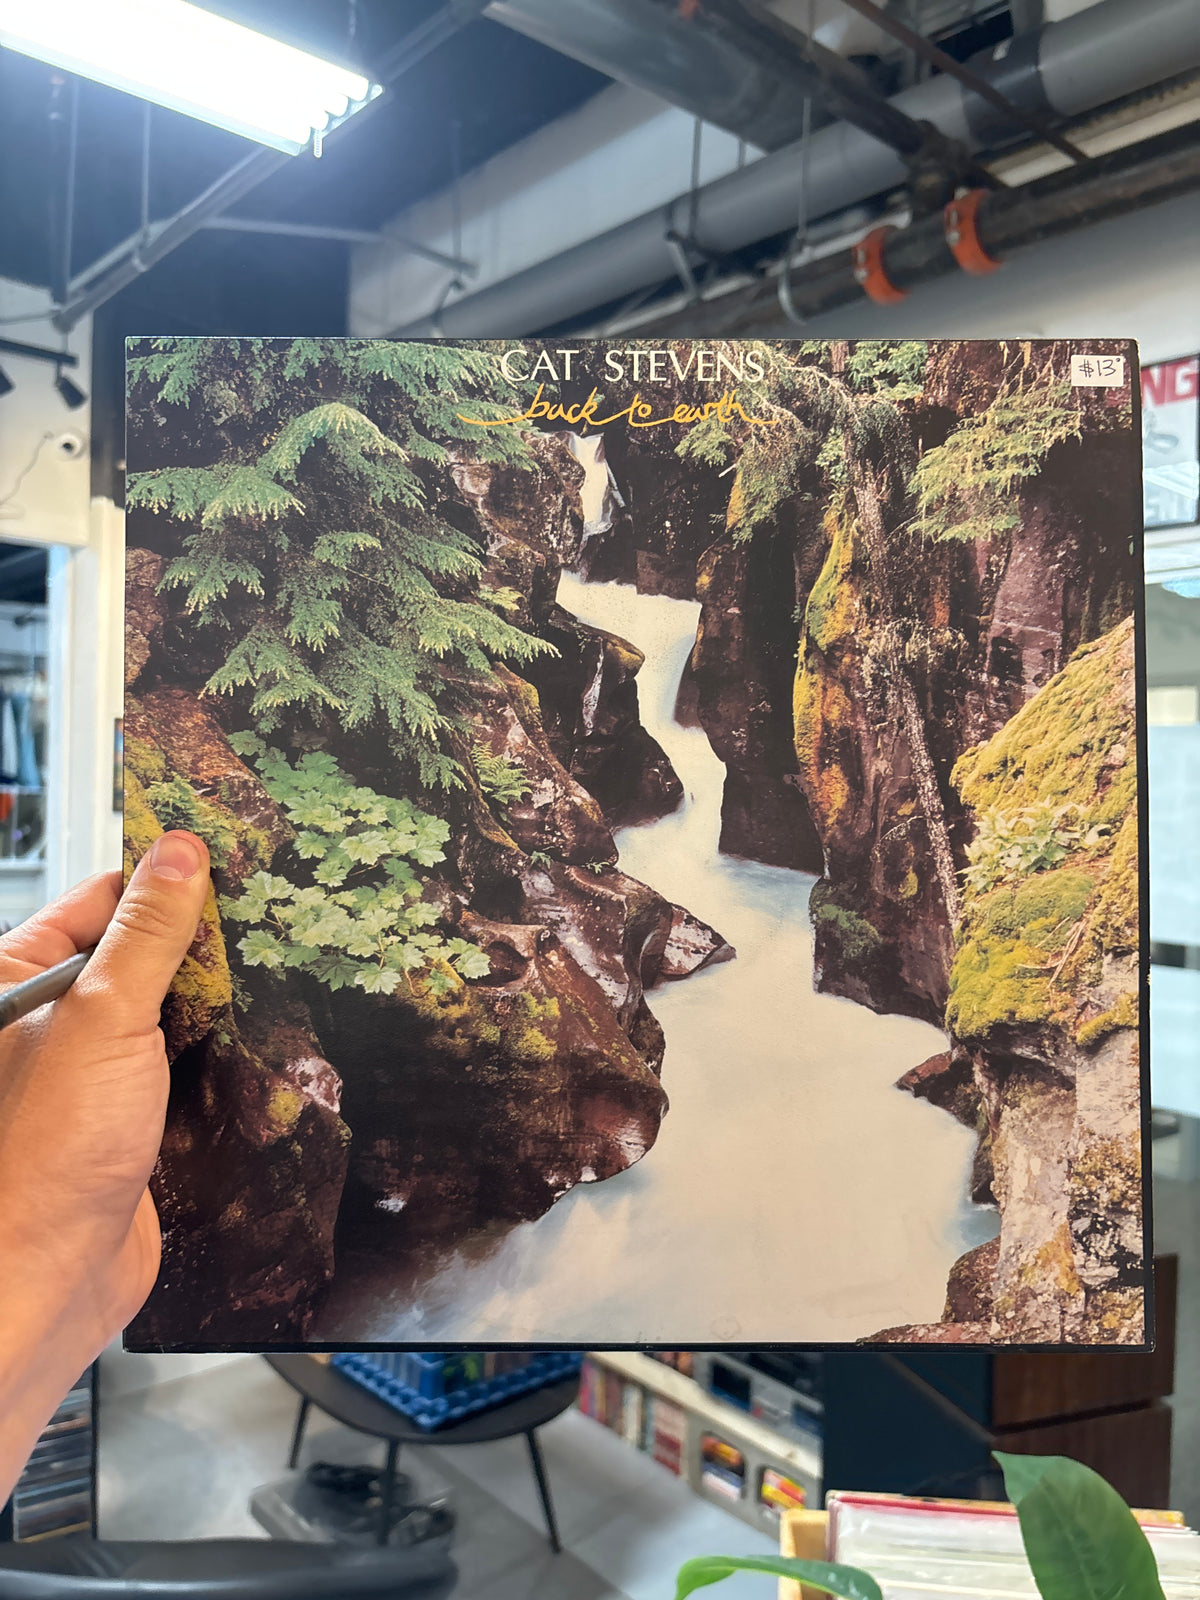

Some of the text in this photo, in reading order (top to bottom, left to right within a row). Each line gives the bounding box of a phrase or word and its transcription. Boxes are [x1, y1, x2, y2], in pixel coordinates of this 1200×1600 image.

[501, 349, 765, 382] CAT STEVENS
[457, 383, 602, 425] back
[672, 389, 777, 424] earth
